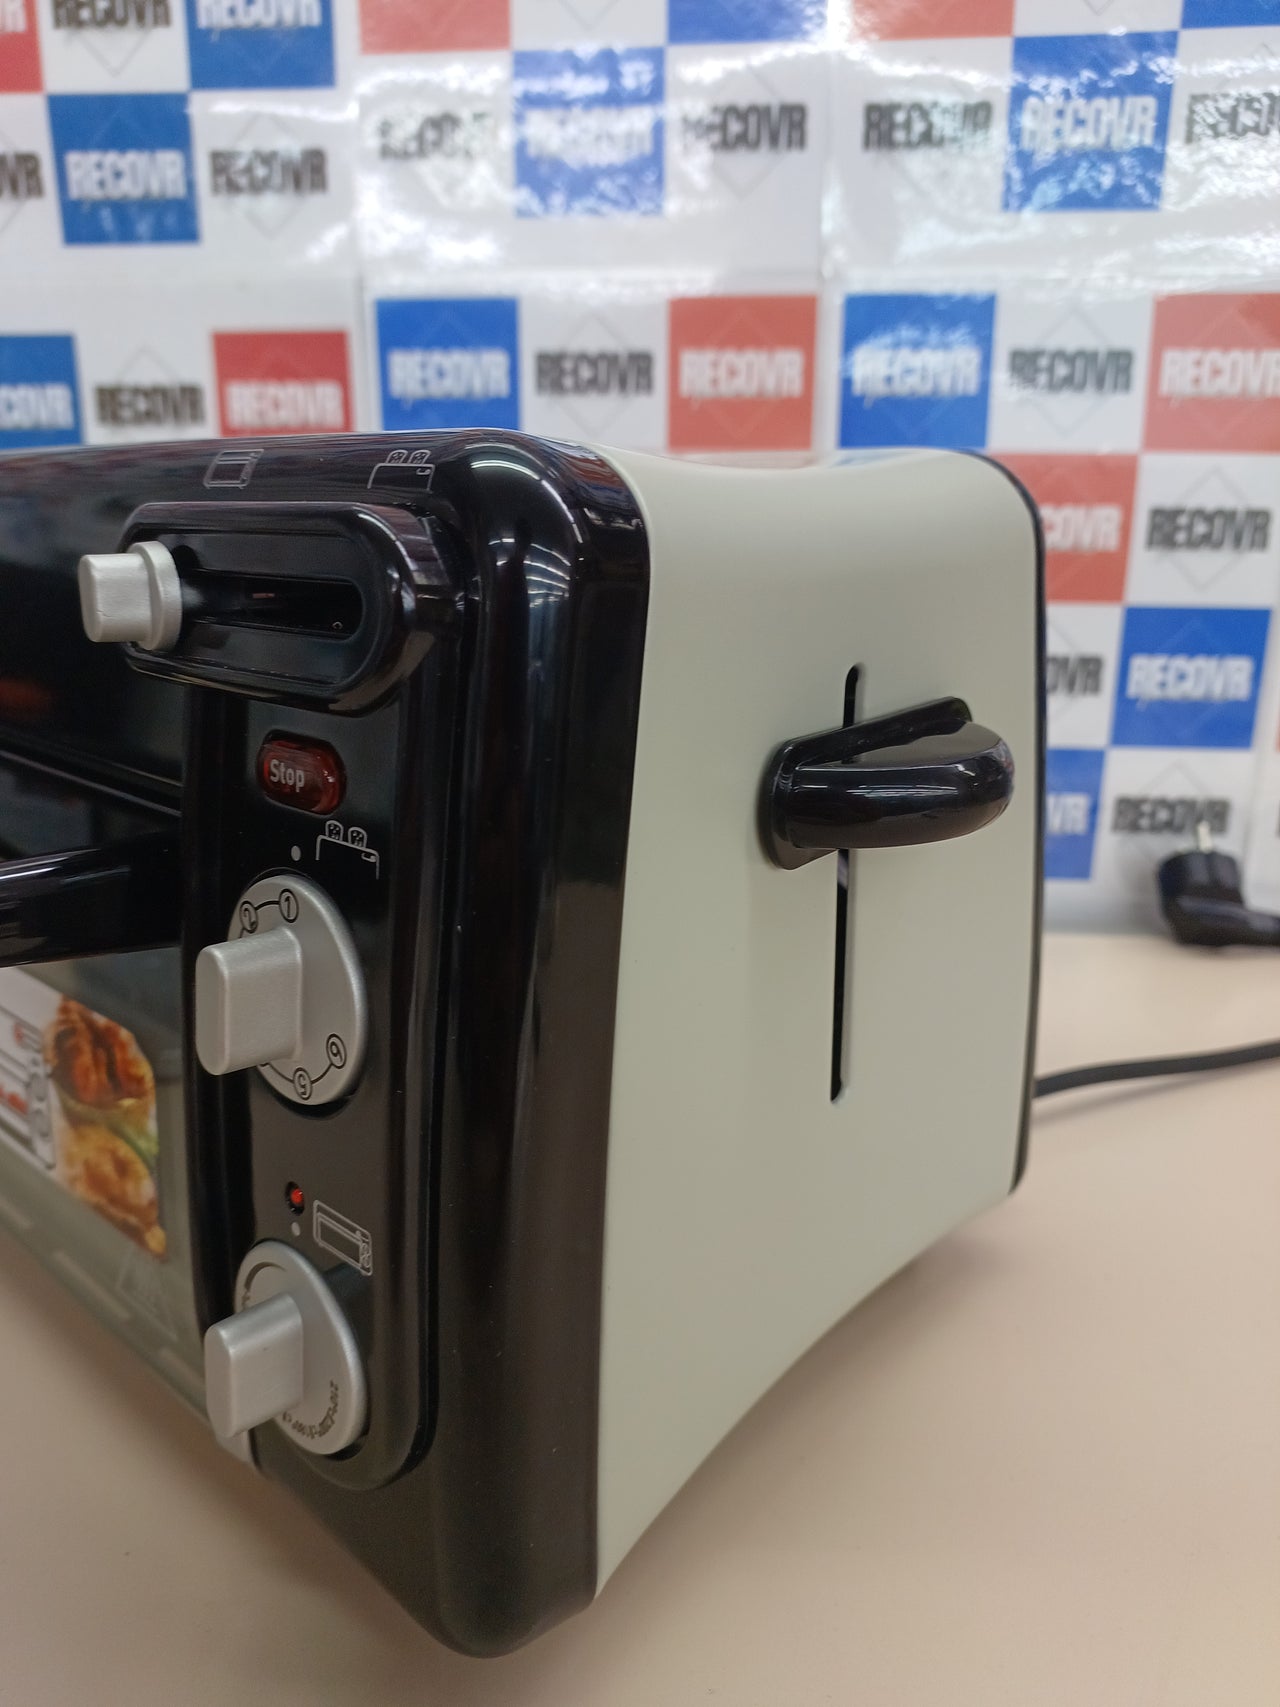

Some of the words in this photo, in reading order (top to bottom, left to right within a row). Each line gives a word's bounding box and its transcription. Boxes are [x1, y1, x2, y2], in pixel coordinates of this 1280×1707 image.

[64, 150, 187, 199] RECOVR
[388, 350, 511, 398] RECOVR
[535, 350, 653, 396] RECOVR
[679, 348, 804, 398] RECOVR
[95, 384, 205, 427] RECOVR
[227, 380, 344, 430] RECOVR
[1042, 504, 1122, 552] COVR
[1146, 508, 1271, 551] RECOVR
[1126, 655, 1255, 701] RECOVR
[270, 759, 305, 793] Stop
